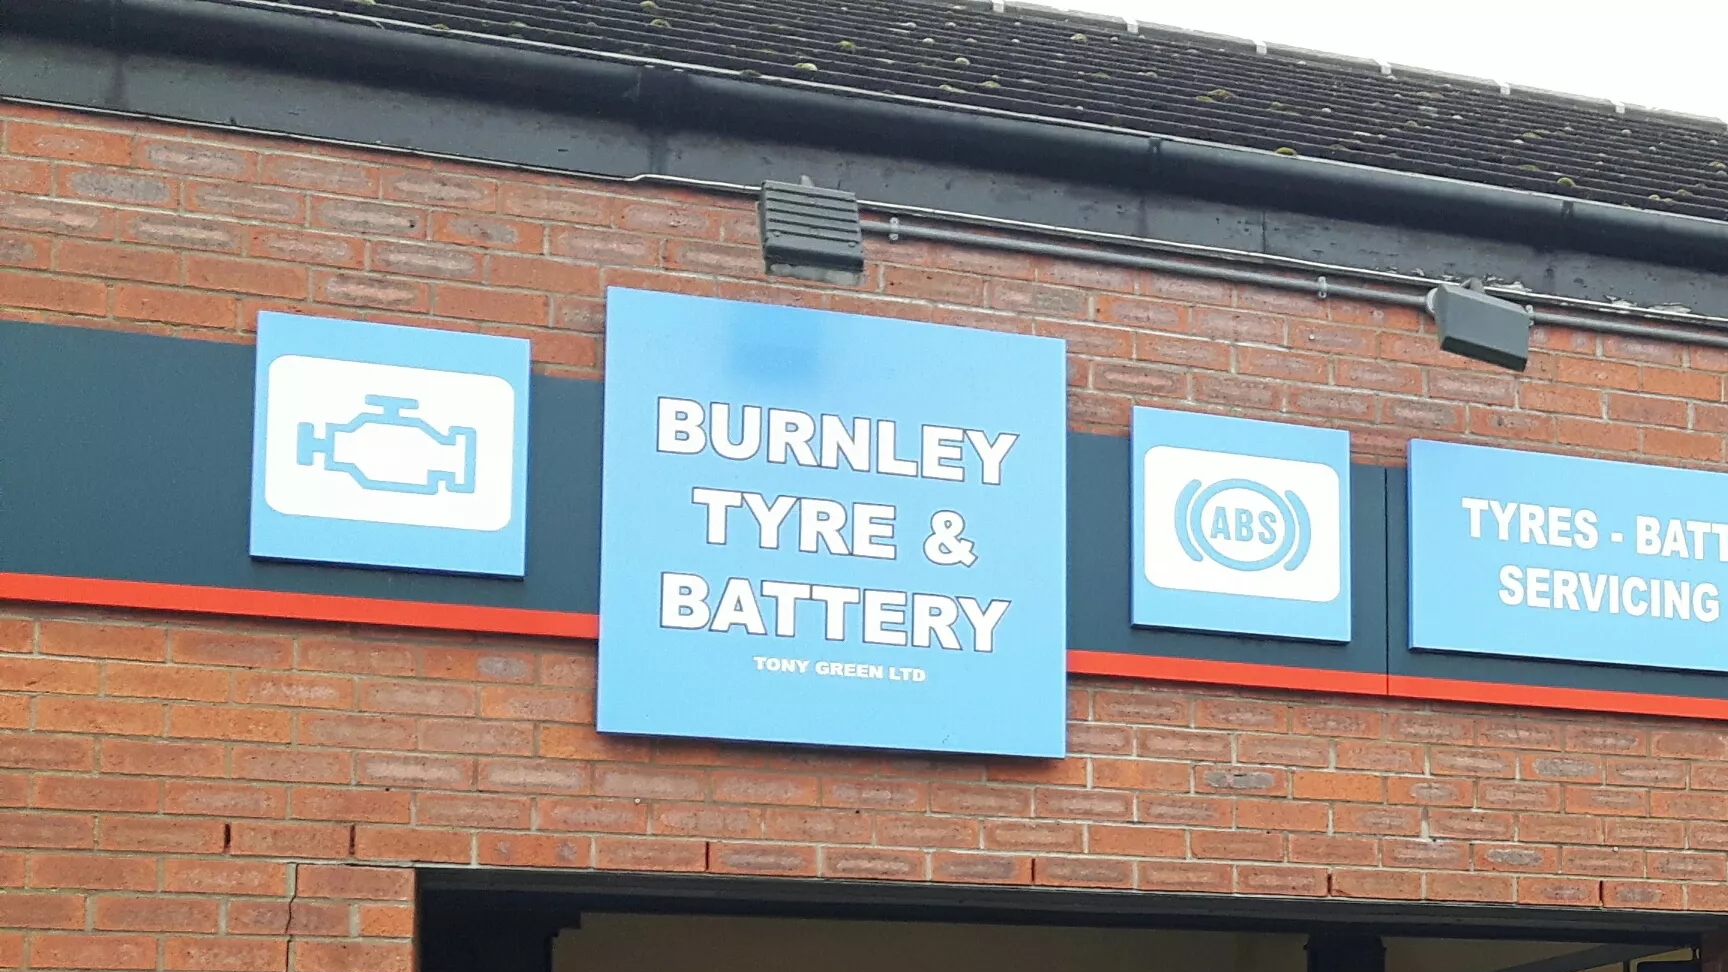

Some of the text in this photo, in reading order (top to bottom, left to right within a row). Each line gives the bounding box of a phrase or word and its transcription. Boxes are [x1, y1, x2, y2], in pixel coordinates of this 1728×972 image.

[657, 396, 1020, 485] BURNLEY
[692, 487, 977, 567] TYRE &
[1210, 506, 1277, 546] ABS
[1461, 497, 1599, 550] TYRES
[1610, 532, 1624, 543] -
[659, 573, 1010, 653] BATTERY
[1498, 564, 1720, 623] SERVICING
[753, 656, 927, 682] TONY GREEN LTD
